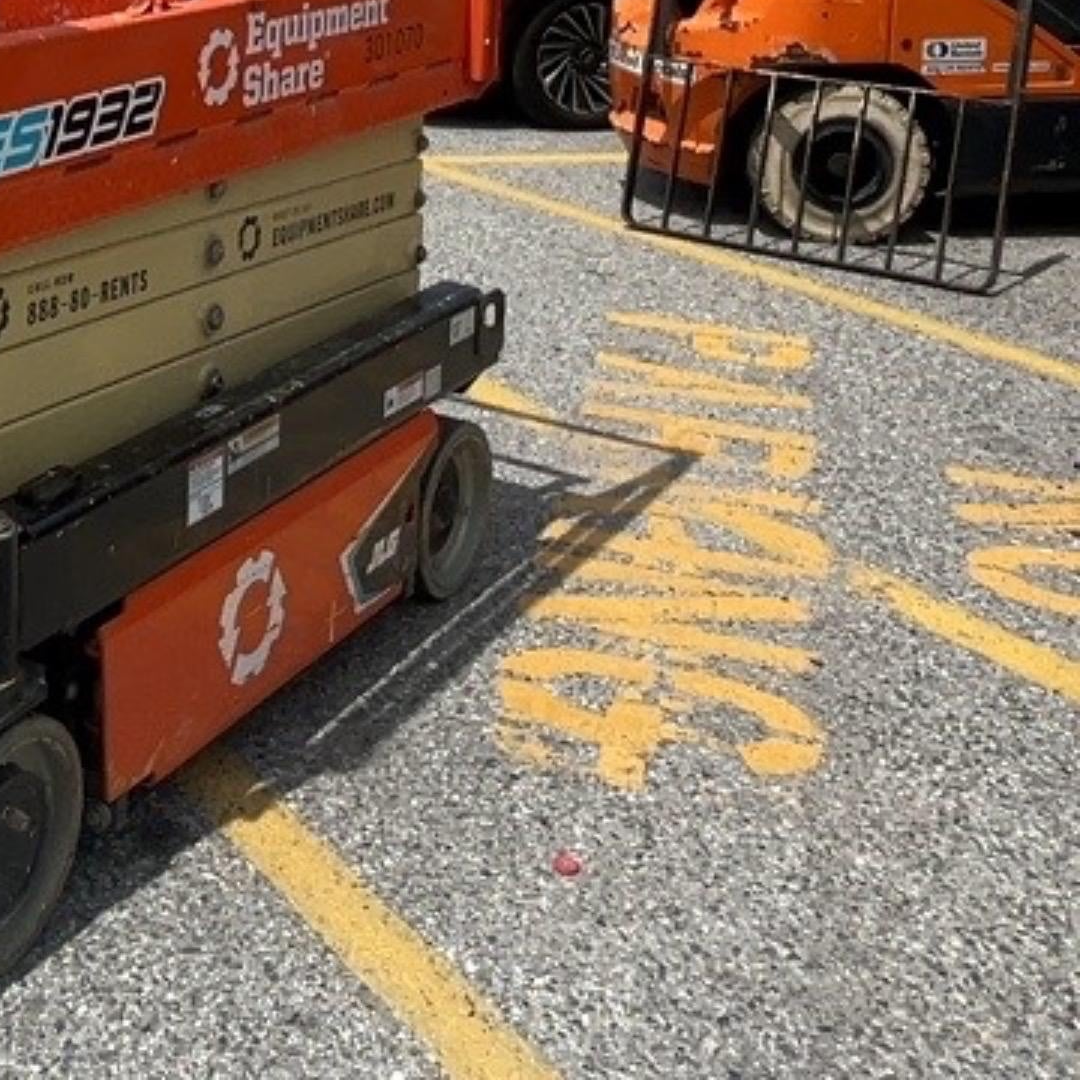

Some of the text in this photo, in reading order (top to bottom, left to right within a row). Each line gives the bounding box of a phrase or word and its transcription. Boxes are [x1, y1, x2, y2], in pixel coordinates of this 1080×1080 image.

[365, 23, 425, 64] 301070
[242, 59, 326, 108] Share
[26, 268, 149, 326] 888-80-RENTS
